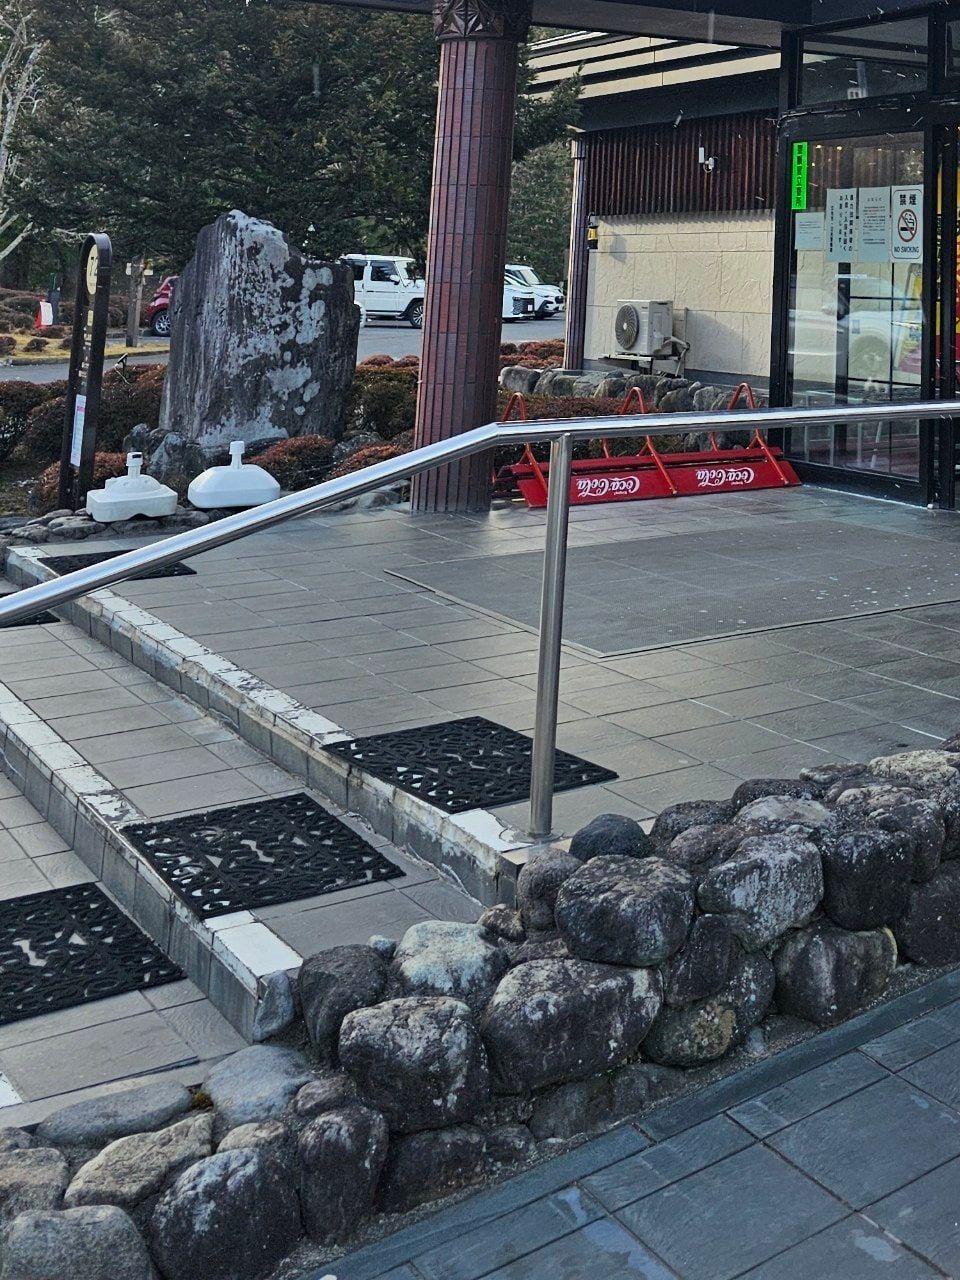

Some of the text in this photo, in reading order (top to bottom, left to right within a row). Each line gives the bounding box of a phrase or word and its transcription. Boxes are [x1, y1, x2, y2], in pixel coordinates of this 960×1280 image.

[899, 193, 917, 206] 禁煙
[901, 245, 919, 253] SMOKING
[695, 467, 755, 487] Coca-Cola
[576, 476, 640, 497] Coca-Cola
